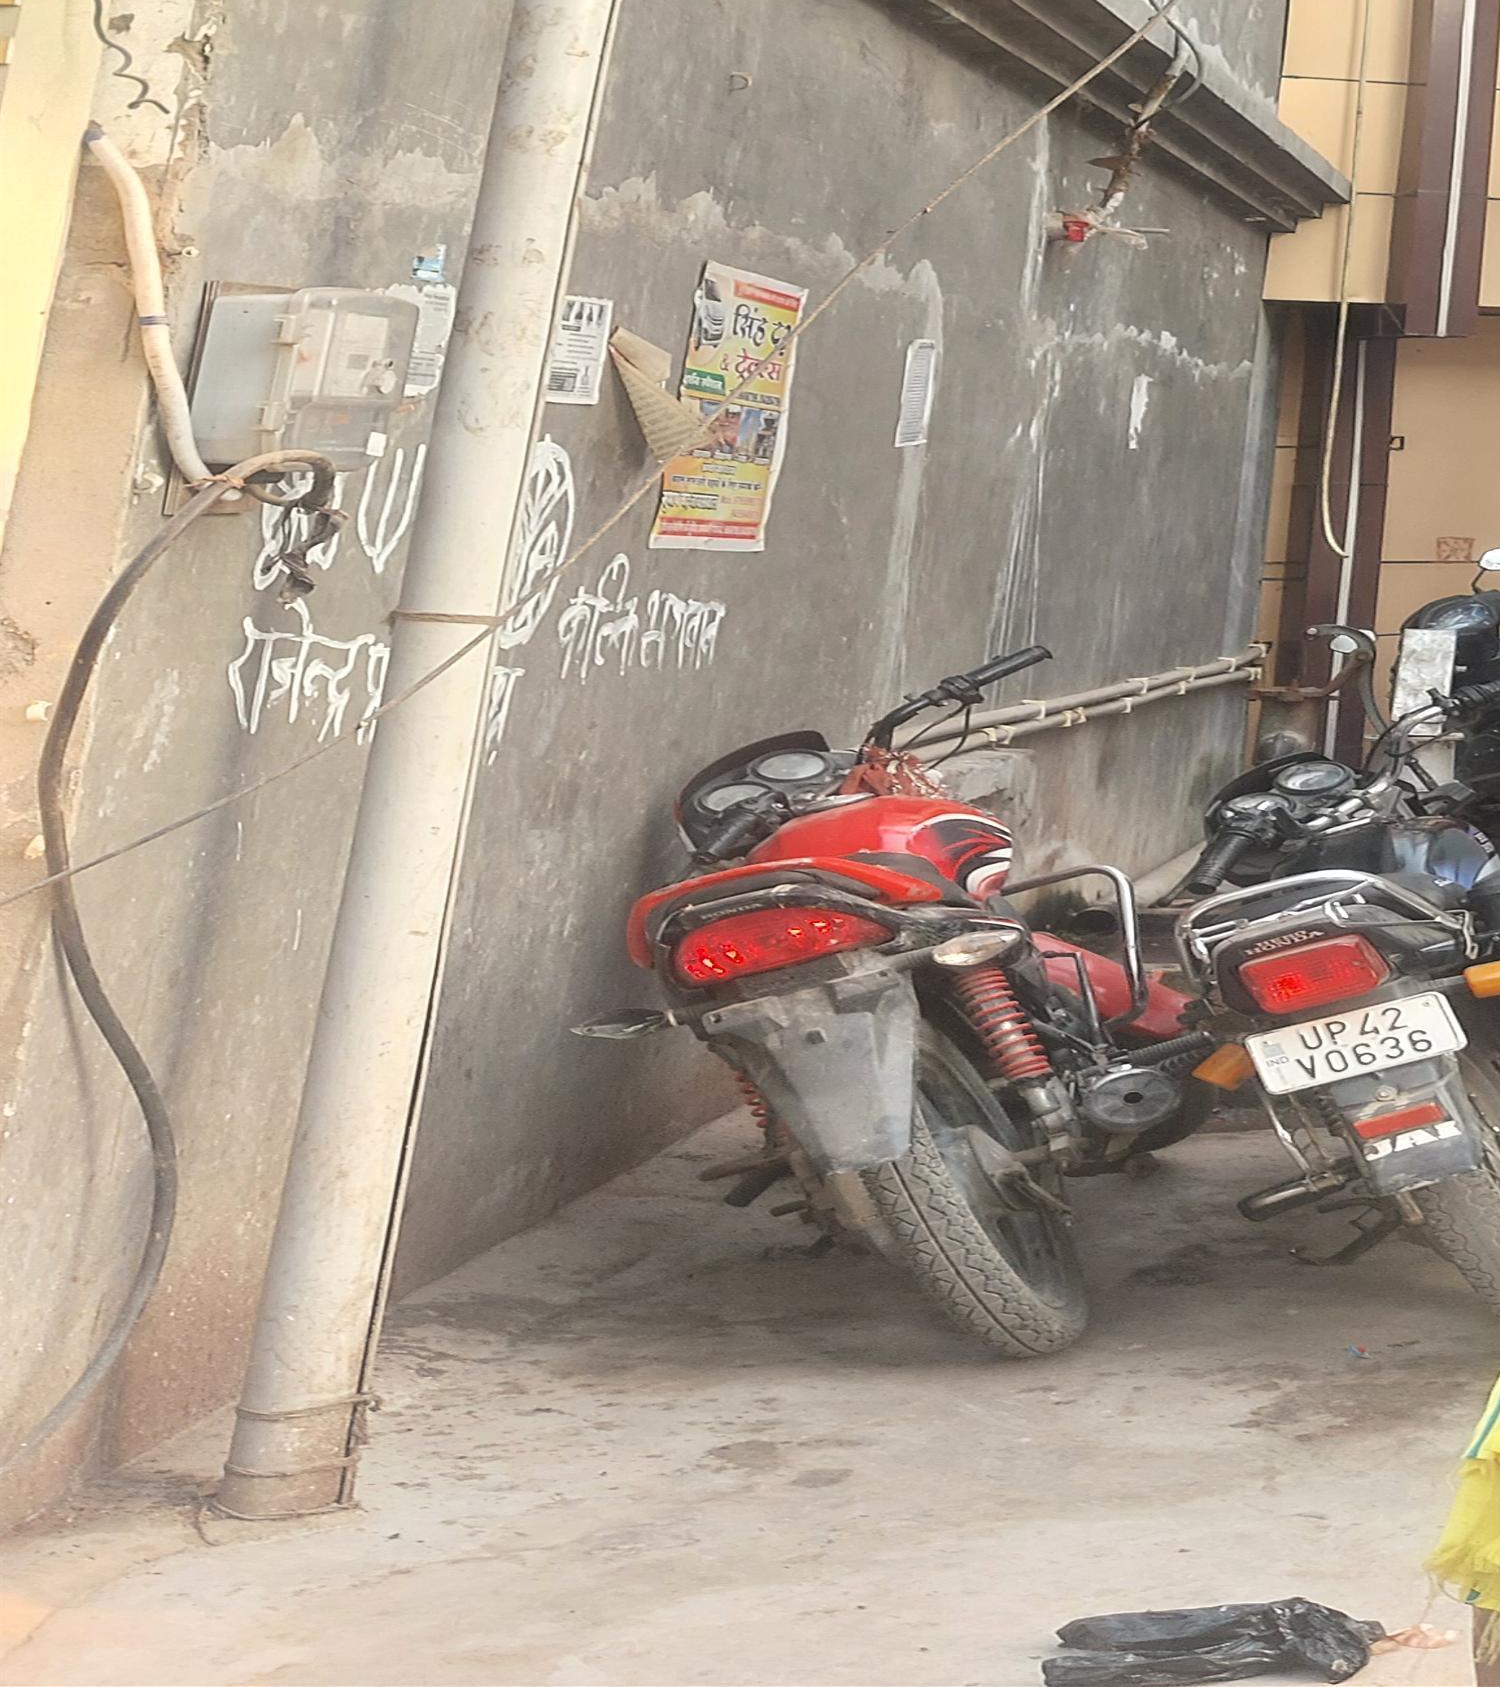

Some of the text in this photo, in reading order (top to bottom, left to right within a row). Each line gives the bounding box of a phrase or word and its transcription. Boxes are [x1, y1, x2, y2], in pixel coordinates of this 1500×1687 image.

[733, 303, 769, 347] सिंह
[1299, 1007, 1408, 1051] UP 42
[1296, 1029, 1433, 1079] V0636
